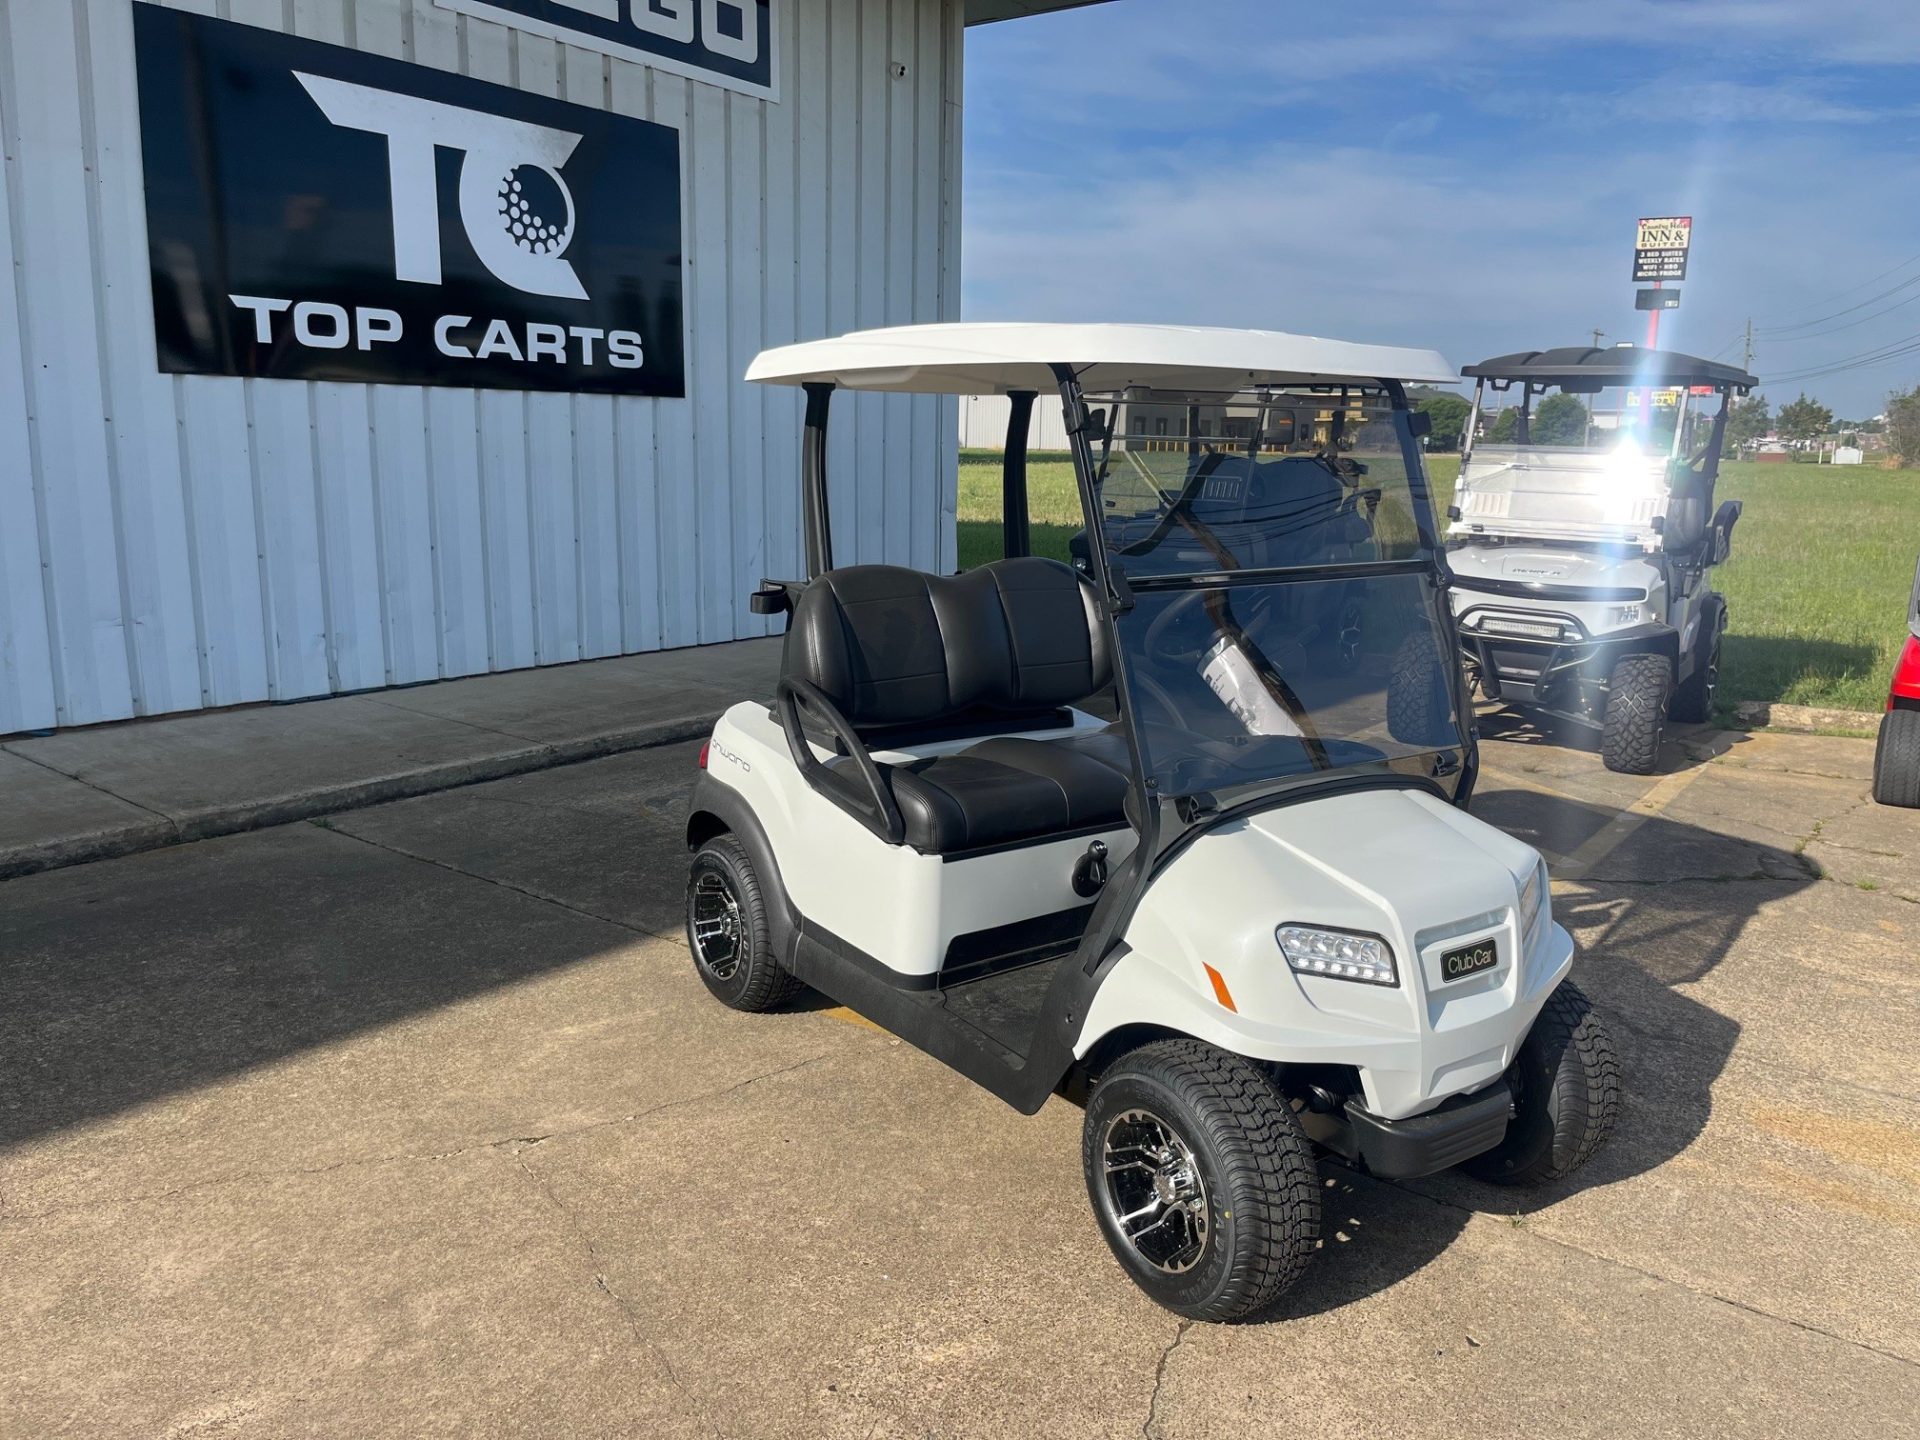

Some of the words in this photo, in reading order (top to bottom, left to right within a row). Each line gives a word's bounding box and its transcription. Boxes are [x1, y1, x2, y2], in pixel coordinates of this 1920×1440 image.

[1641, 230, 1672, 242] INN
[1674, 230, 1684, 241] &
[228, 294, 403, 351] TOP
[434, 315, 644, 369] CARTS
